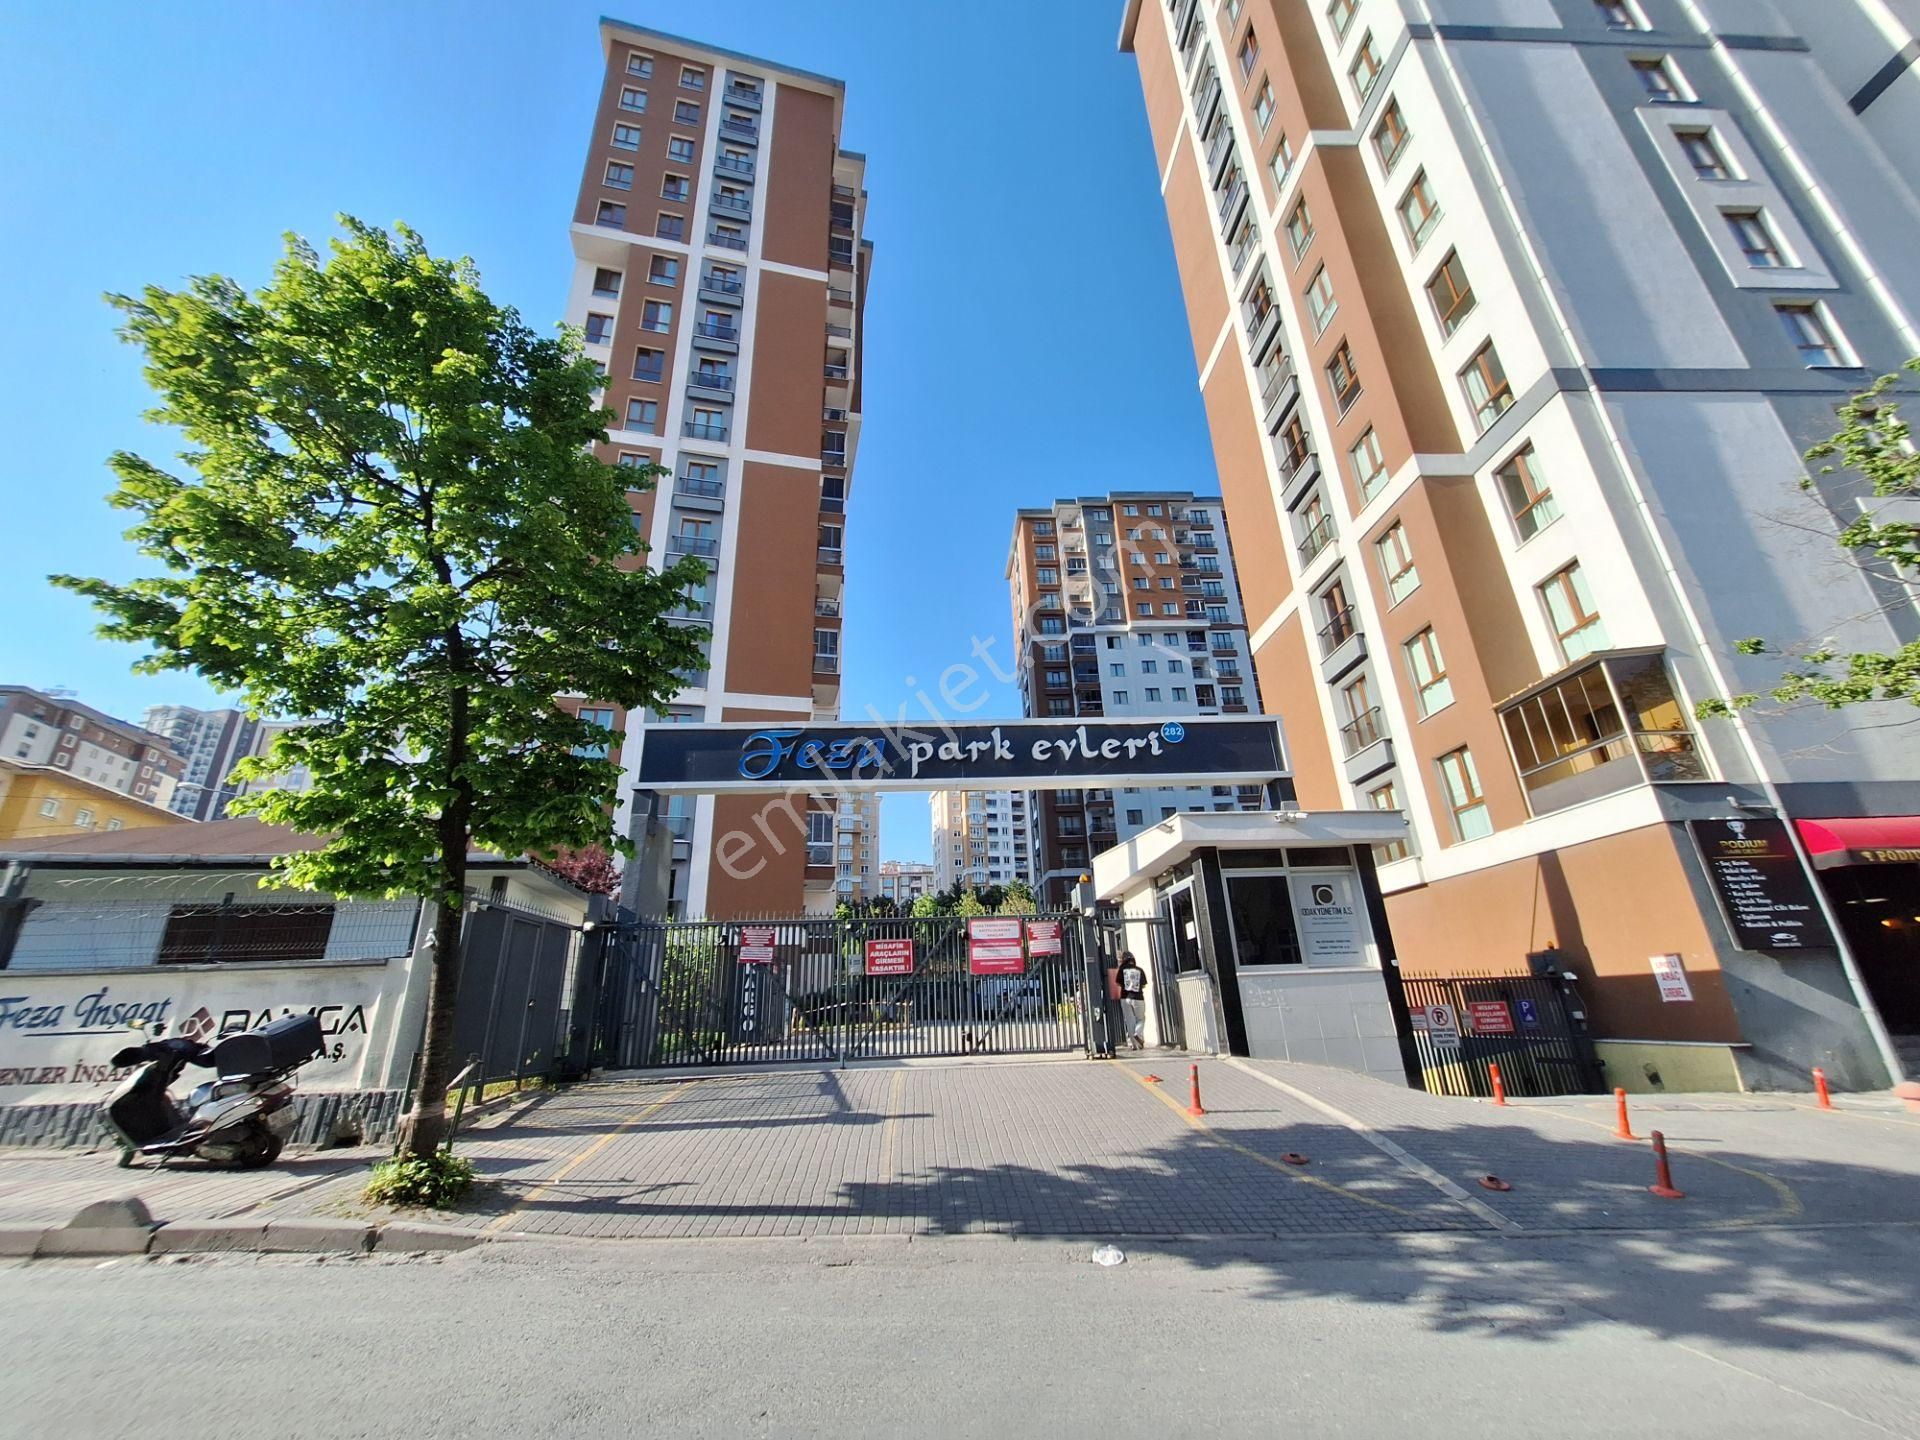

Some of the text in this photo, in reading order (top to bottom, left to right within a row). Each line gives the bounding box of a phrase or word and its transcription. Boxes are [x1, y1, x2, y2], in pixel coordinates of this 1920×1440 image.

[1163, 727, 1182, 736] 282
[737, 726, 1164, 779] Feza park evleri
[1718, 840, 1769, 849] PODIUM
[875, 957, 904, 965] GİRMESİ
